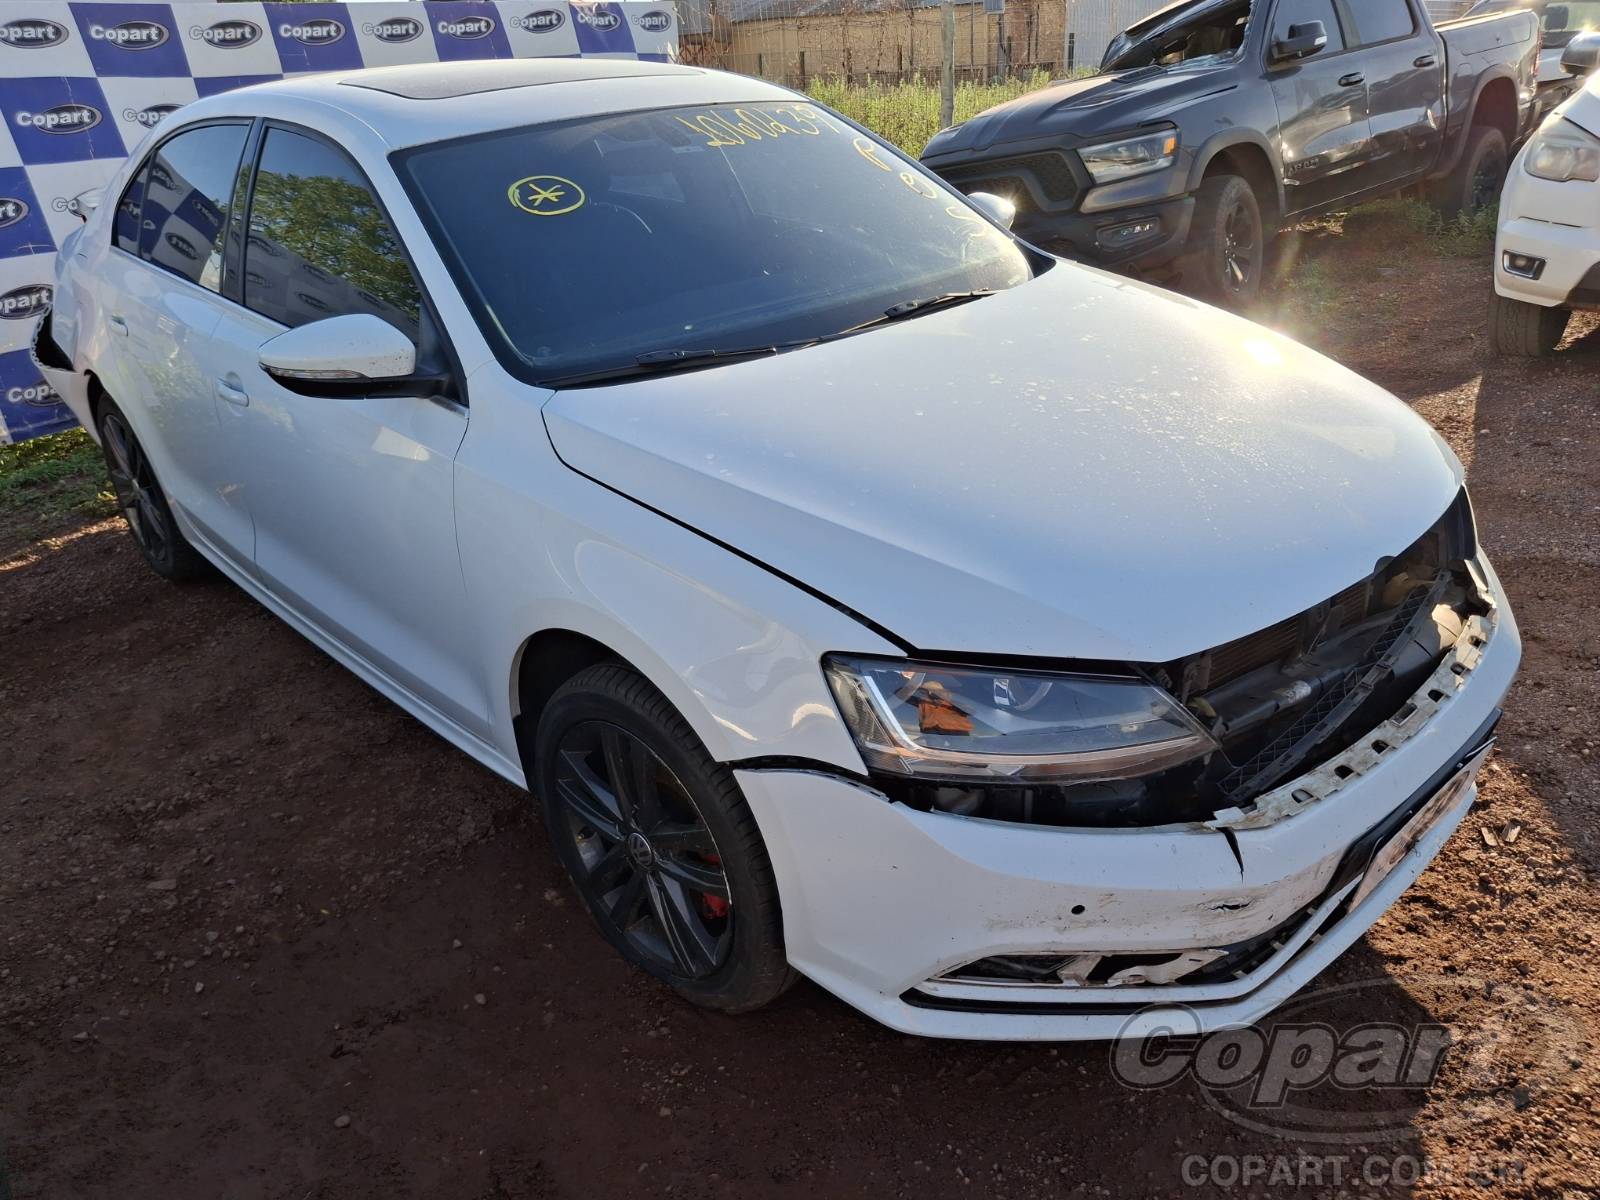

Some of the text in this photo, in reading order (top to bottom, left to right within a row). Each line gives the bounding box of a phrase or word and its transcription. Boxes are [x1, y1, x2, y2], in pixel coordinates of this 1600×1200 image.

[511, 15, 559, 28] Copart
[577, 13, 615, 26] Copart
[631, 15, 666, 26] Copart
[0, 26, 56, 41] opart
[90, 25, 159, 43] Copart
[189, 25, 252, 42] Copart
[279, 22, 337, 39] Copart
[362, 22, 416, 36] Copart
[437, 20, 488, 35] Copart
[16, 107, 92, 129] Copart
[123, 108, 169, 124] Copa
[0, 289, 49, 314] part
